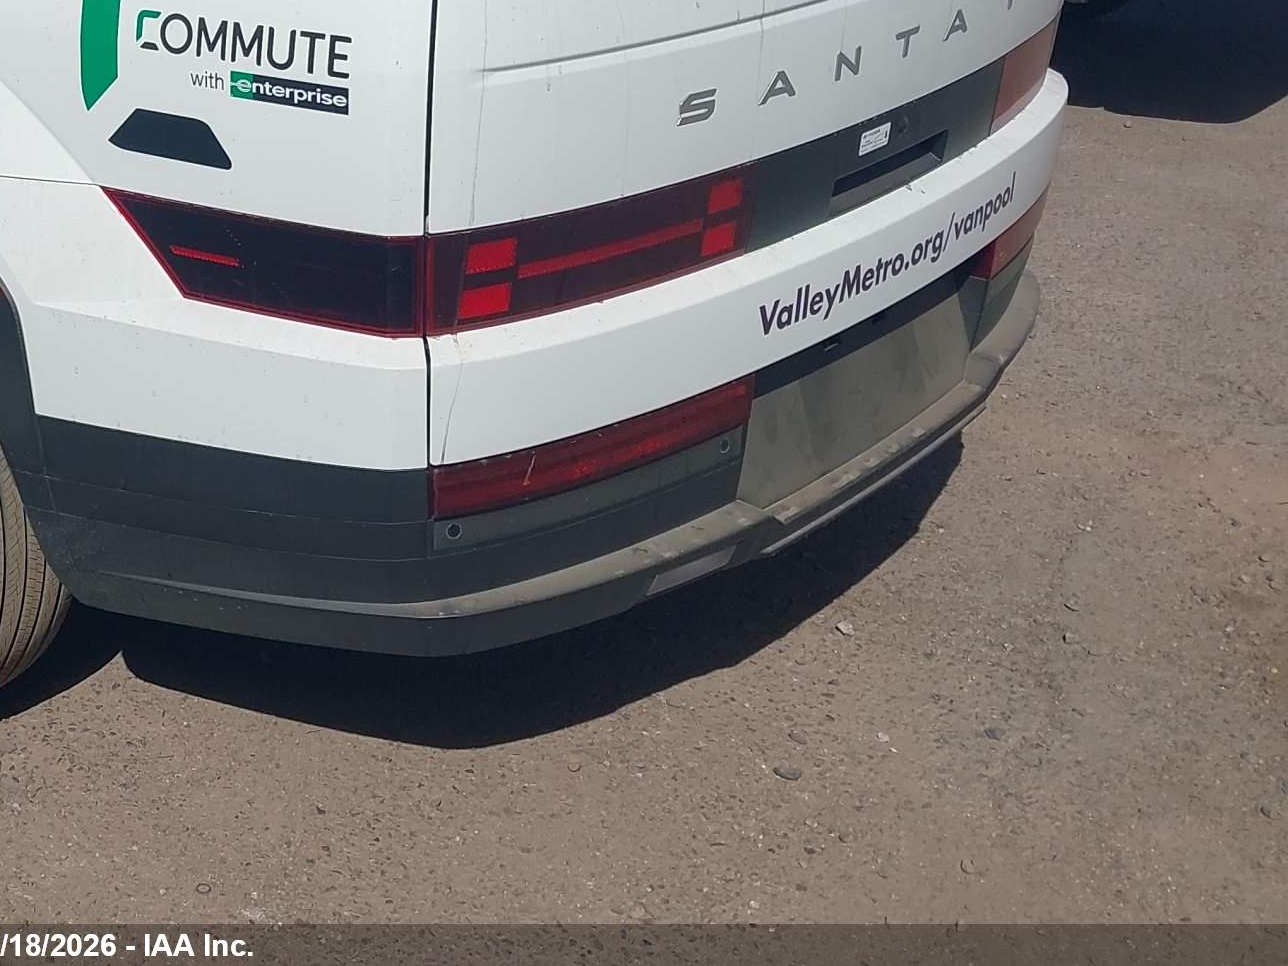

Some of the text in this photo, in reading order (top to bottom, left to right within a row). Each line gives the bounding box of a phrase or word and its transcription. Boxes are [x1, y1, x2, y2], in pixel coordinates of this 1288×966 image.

[136, 9, 353, 79] COMMUTE
[190, 70, 348, 108] with enterprise
[675, 8, 968, 127] SANTA
[757, 170, 1017, 338] ValleyMetro.org/vanpool
